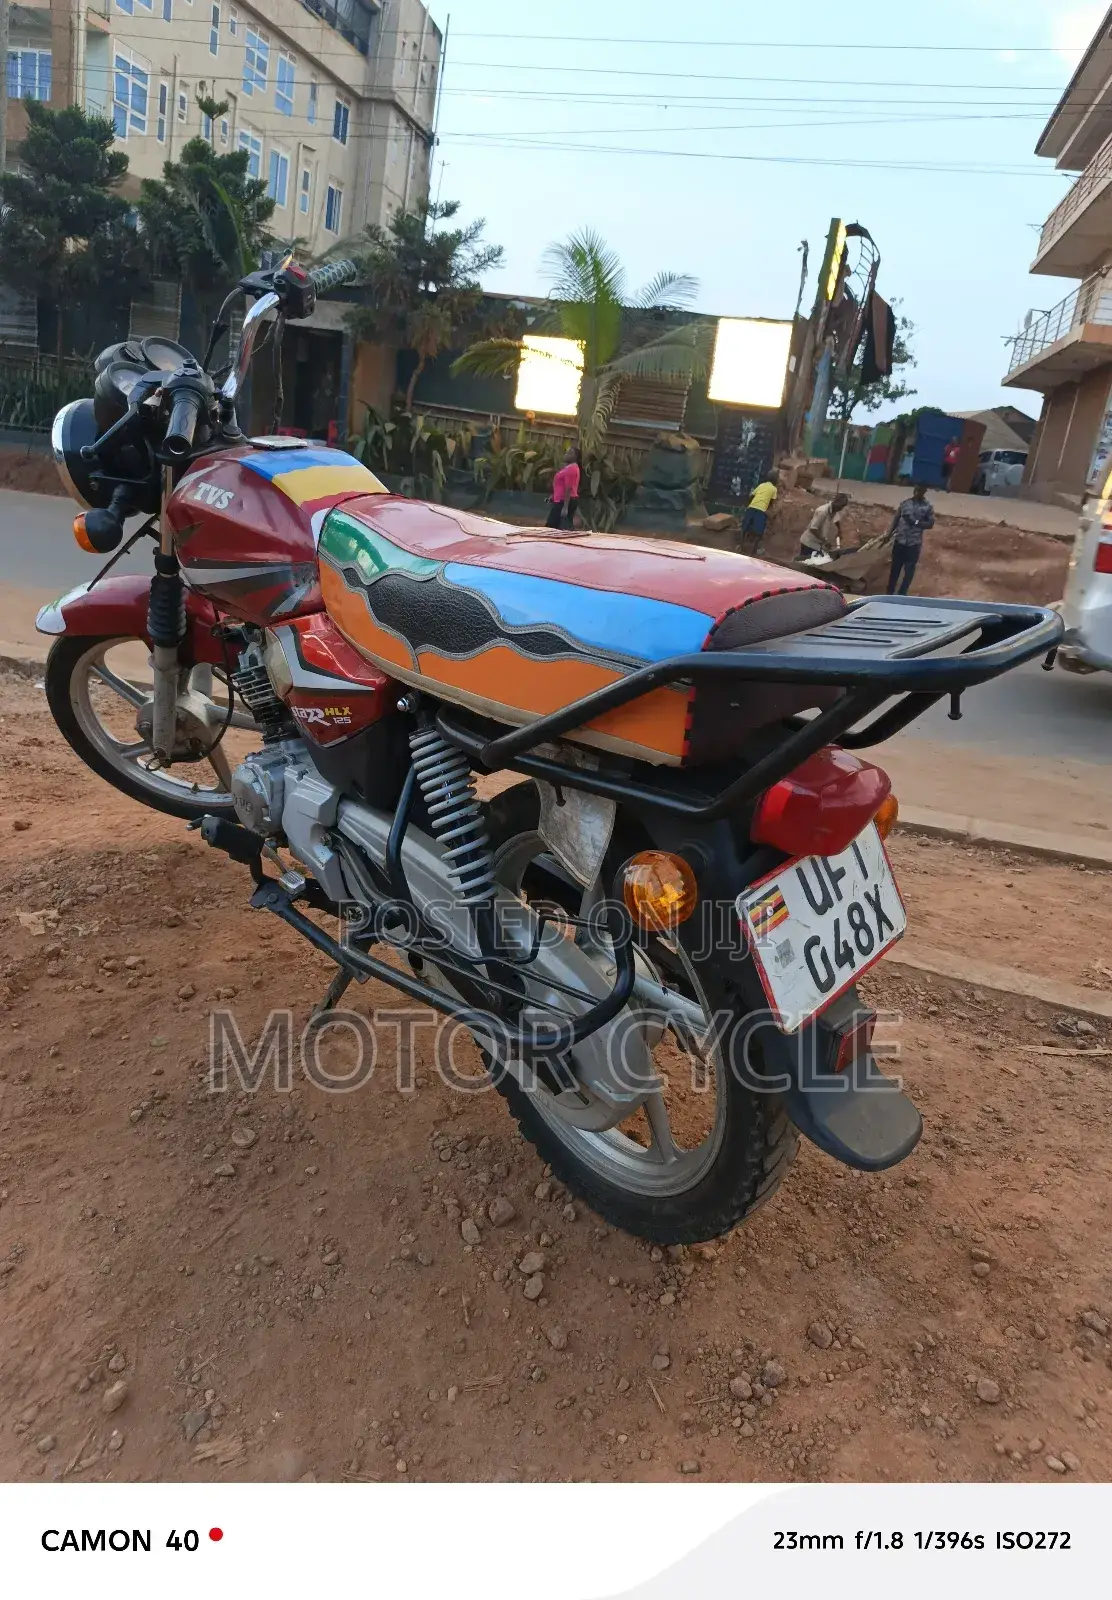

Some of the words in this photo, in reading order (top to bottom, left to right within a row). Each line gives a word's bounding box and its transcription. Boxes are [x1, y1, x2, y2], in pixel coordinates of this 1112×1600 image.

[194, 481, 235, 509] TVS
[324, 706, 352, 716] HLX
[333, 716, 352, 724] 125
